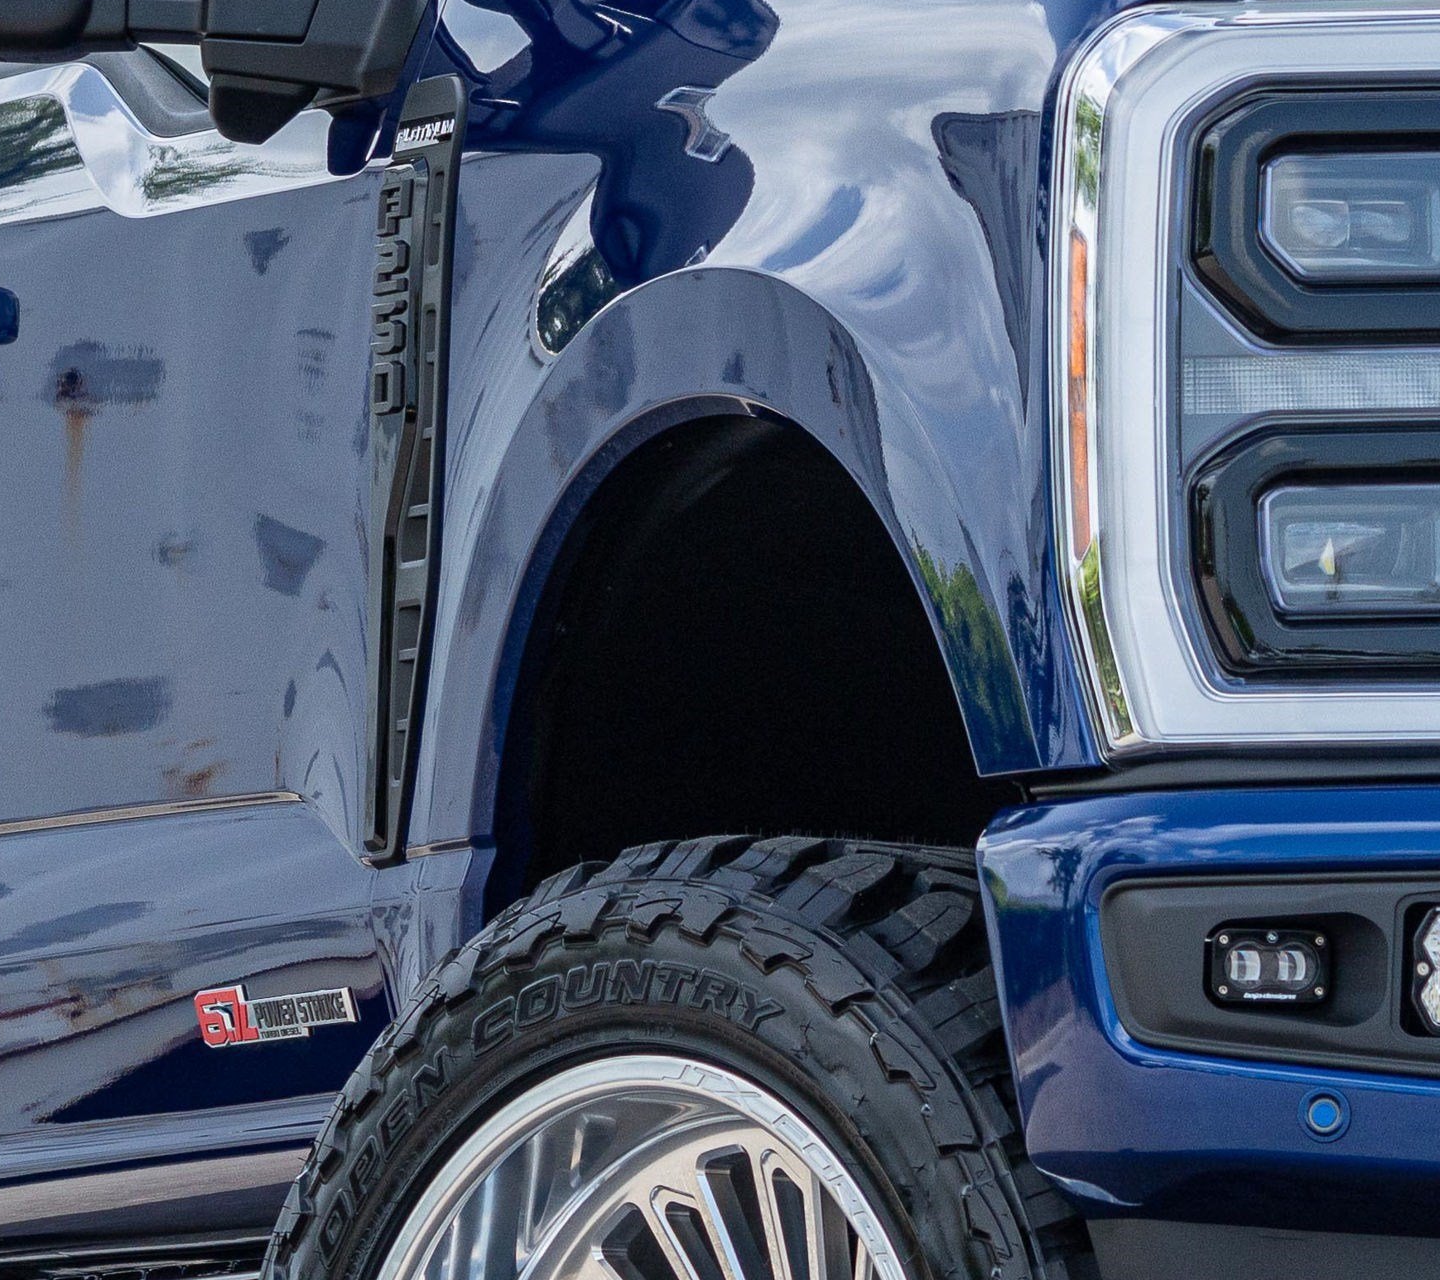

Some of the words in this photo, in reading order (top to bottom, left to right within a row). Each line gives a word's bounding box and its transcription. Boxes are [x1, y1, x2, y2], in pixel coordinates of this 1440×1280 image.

[253, 997, 299, 1029] POWER
[299, 991, 348, 1023] STROKE
[280, 1027, 302, 1038] DIESEL
[660, 1063, 763, 1109] JTX
[316, 1046, 450, 1269] OPEN
[472, 959, 786, 1057] COUNTRY
